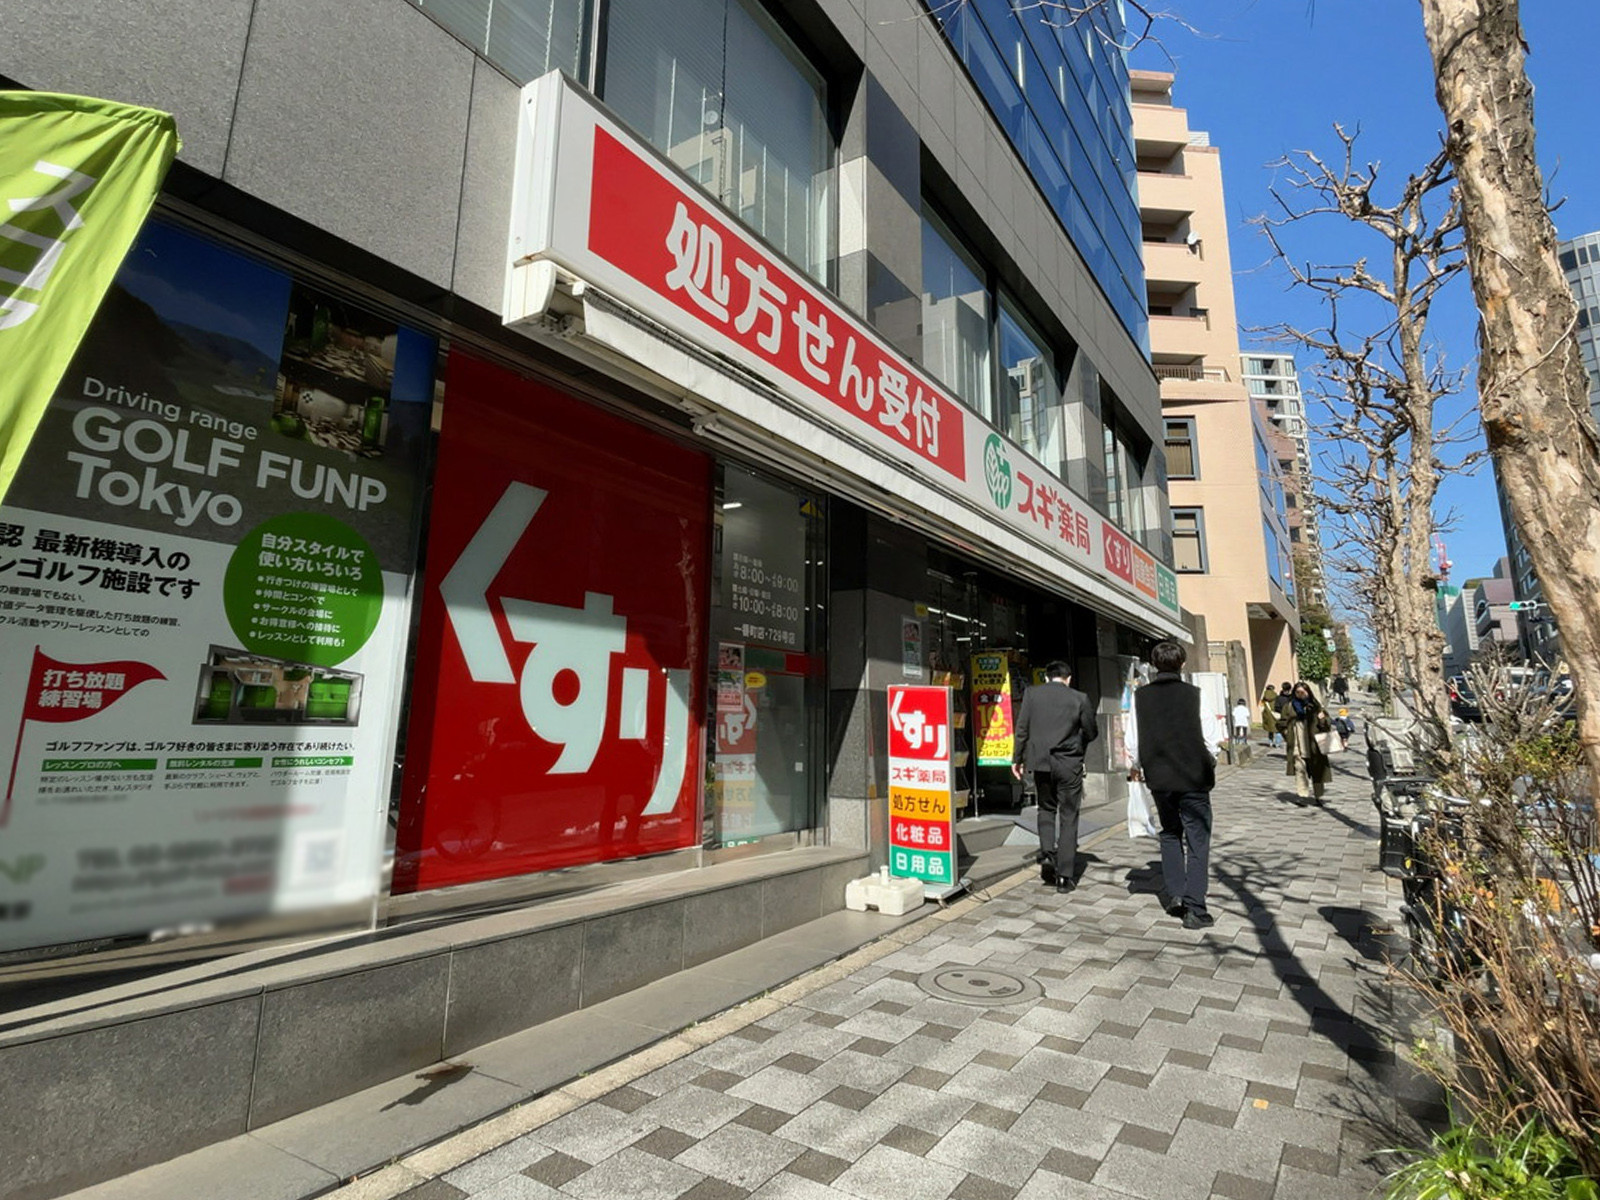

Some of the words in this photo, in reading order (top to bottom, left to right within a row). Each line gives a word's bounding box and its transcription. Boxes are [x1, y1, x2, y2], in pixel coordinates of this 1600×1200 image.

[665, 200, 940, 458] 処方せん受付
[83, 377, 182, 423] Driving
[189, 412, 257, 440] range
[71, 405, 245, 478] GOLF
[256, 449, 388, 512] FUNP
[66, 451, 243, 527] Tokyo
[1016, 470, 1091, 555] スギ薬局
[32, 528, 191, 572] 最新機導入の
[261, 532, 365, 564] 自分スタイルで
[1104, 534, 1131, 575] くすり
[258, 550, 363, 581] 使い方いろいろ
[262, 603, 333, 619] サークルの会場に
[438, 479, 691, 817] くすり
[43, 668, 127, 692] 打ち放題
[38, 690, 103, 710] 練習場
[889, 691, 947, 759] くすり
[45, 761, 122, 769] レッスンプロの方へ
[891, 766, 947, 784] スギ薬局
[893, 794, 946, 815] 処方せん
[896, 823, 943, 845] 化粧品
[896, 852, 945, 876] 日用品
